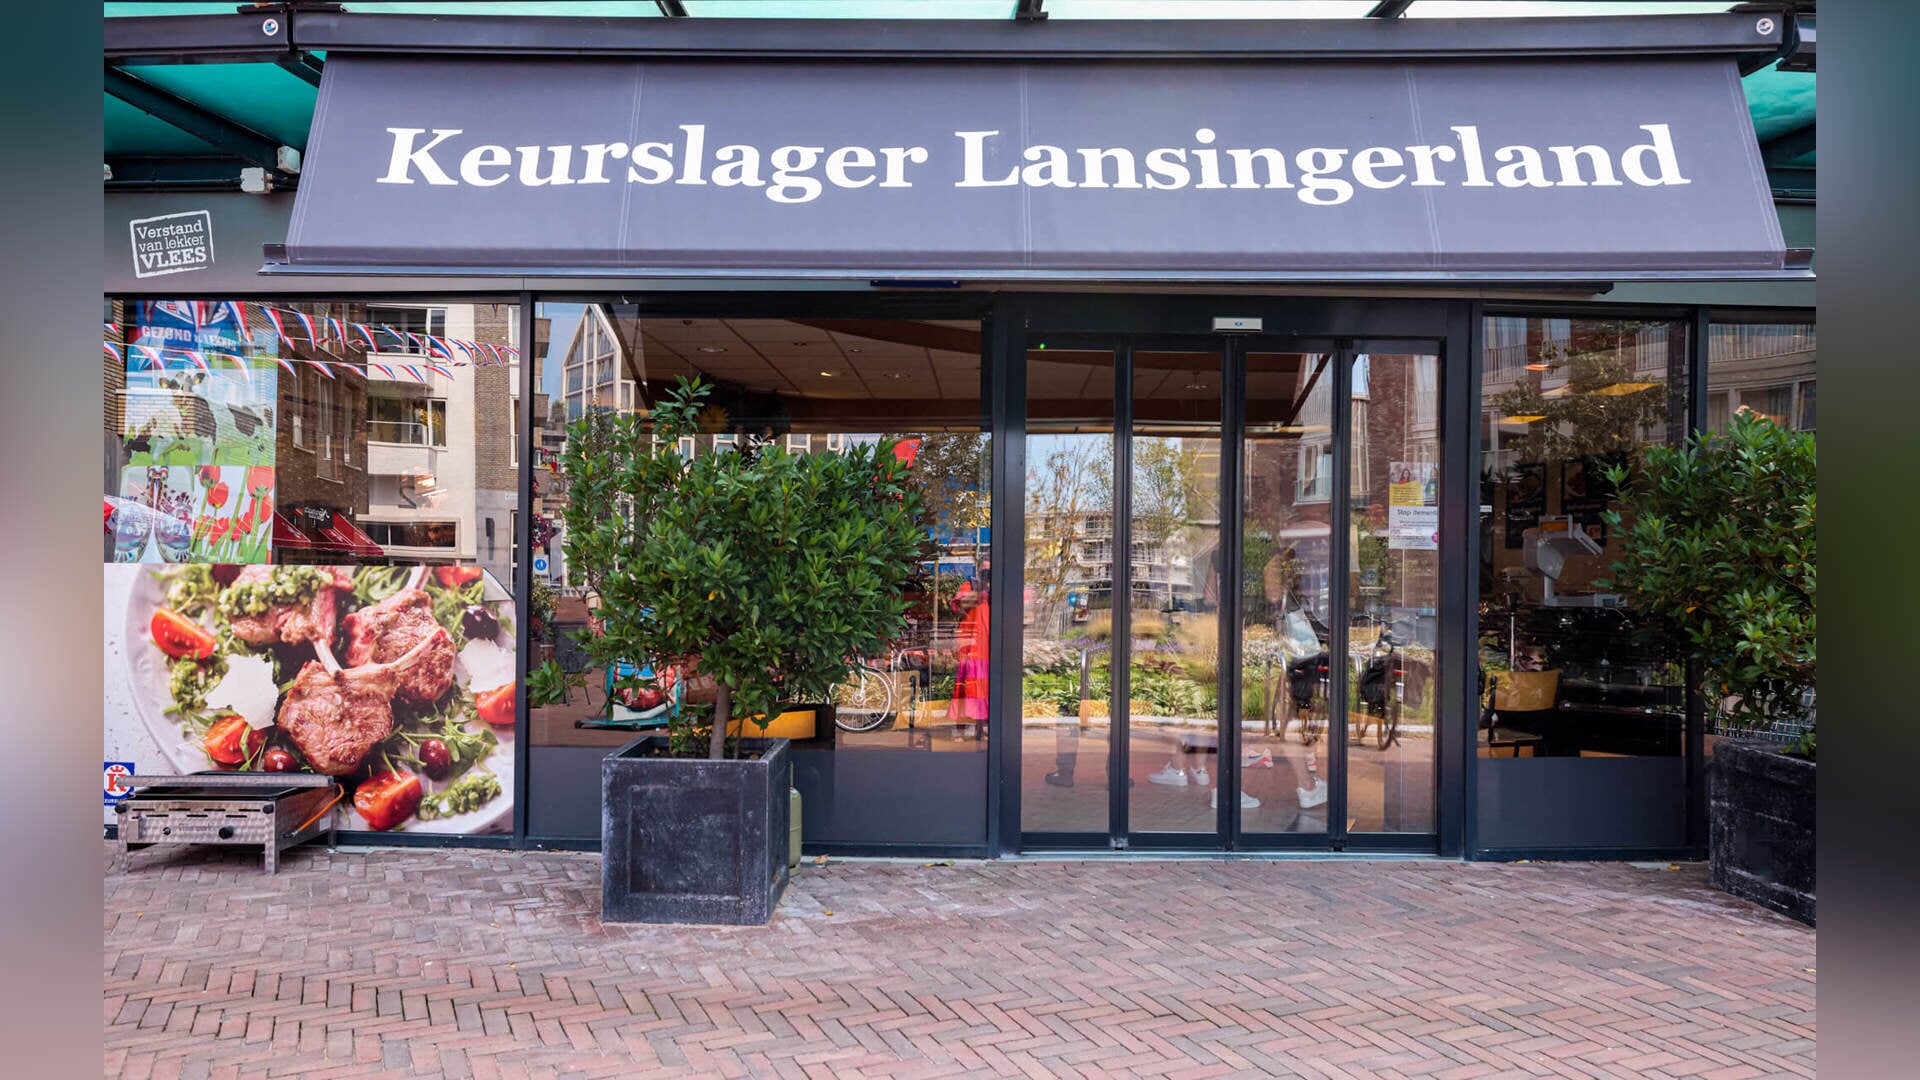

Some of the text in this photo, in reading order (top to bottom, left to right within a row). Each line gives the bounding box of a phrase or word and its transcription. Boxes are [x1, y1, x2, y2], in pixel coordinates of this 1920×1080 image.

[376, 123, 1692, 206] Keurslager Lansingerland
[136, 219, 203, 240] Verstand
[138, 234, 205, 253] van lekker
[140, 246, 207, 269] VLEES
